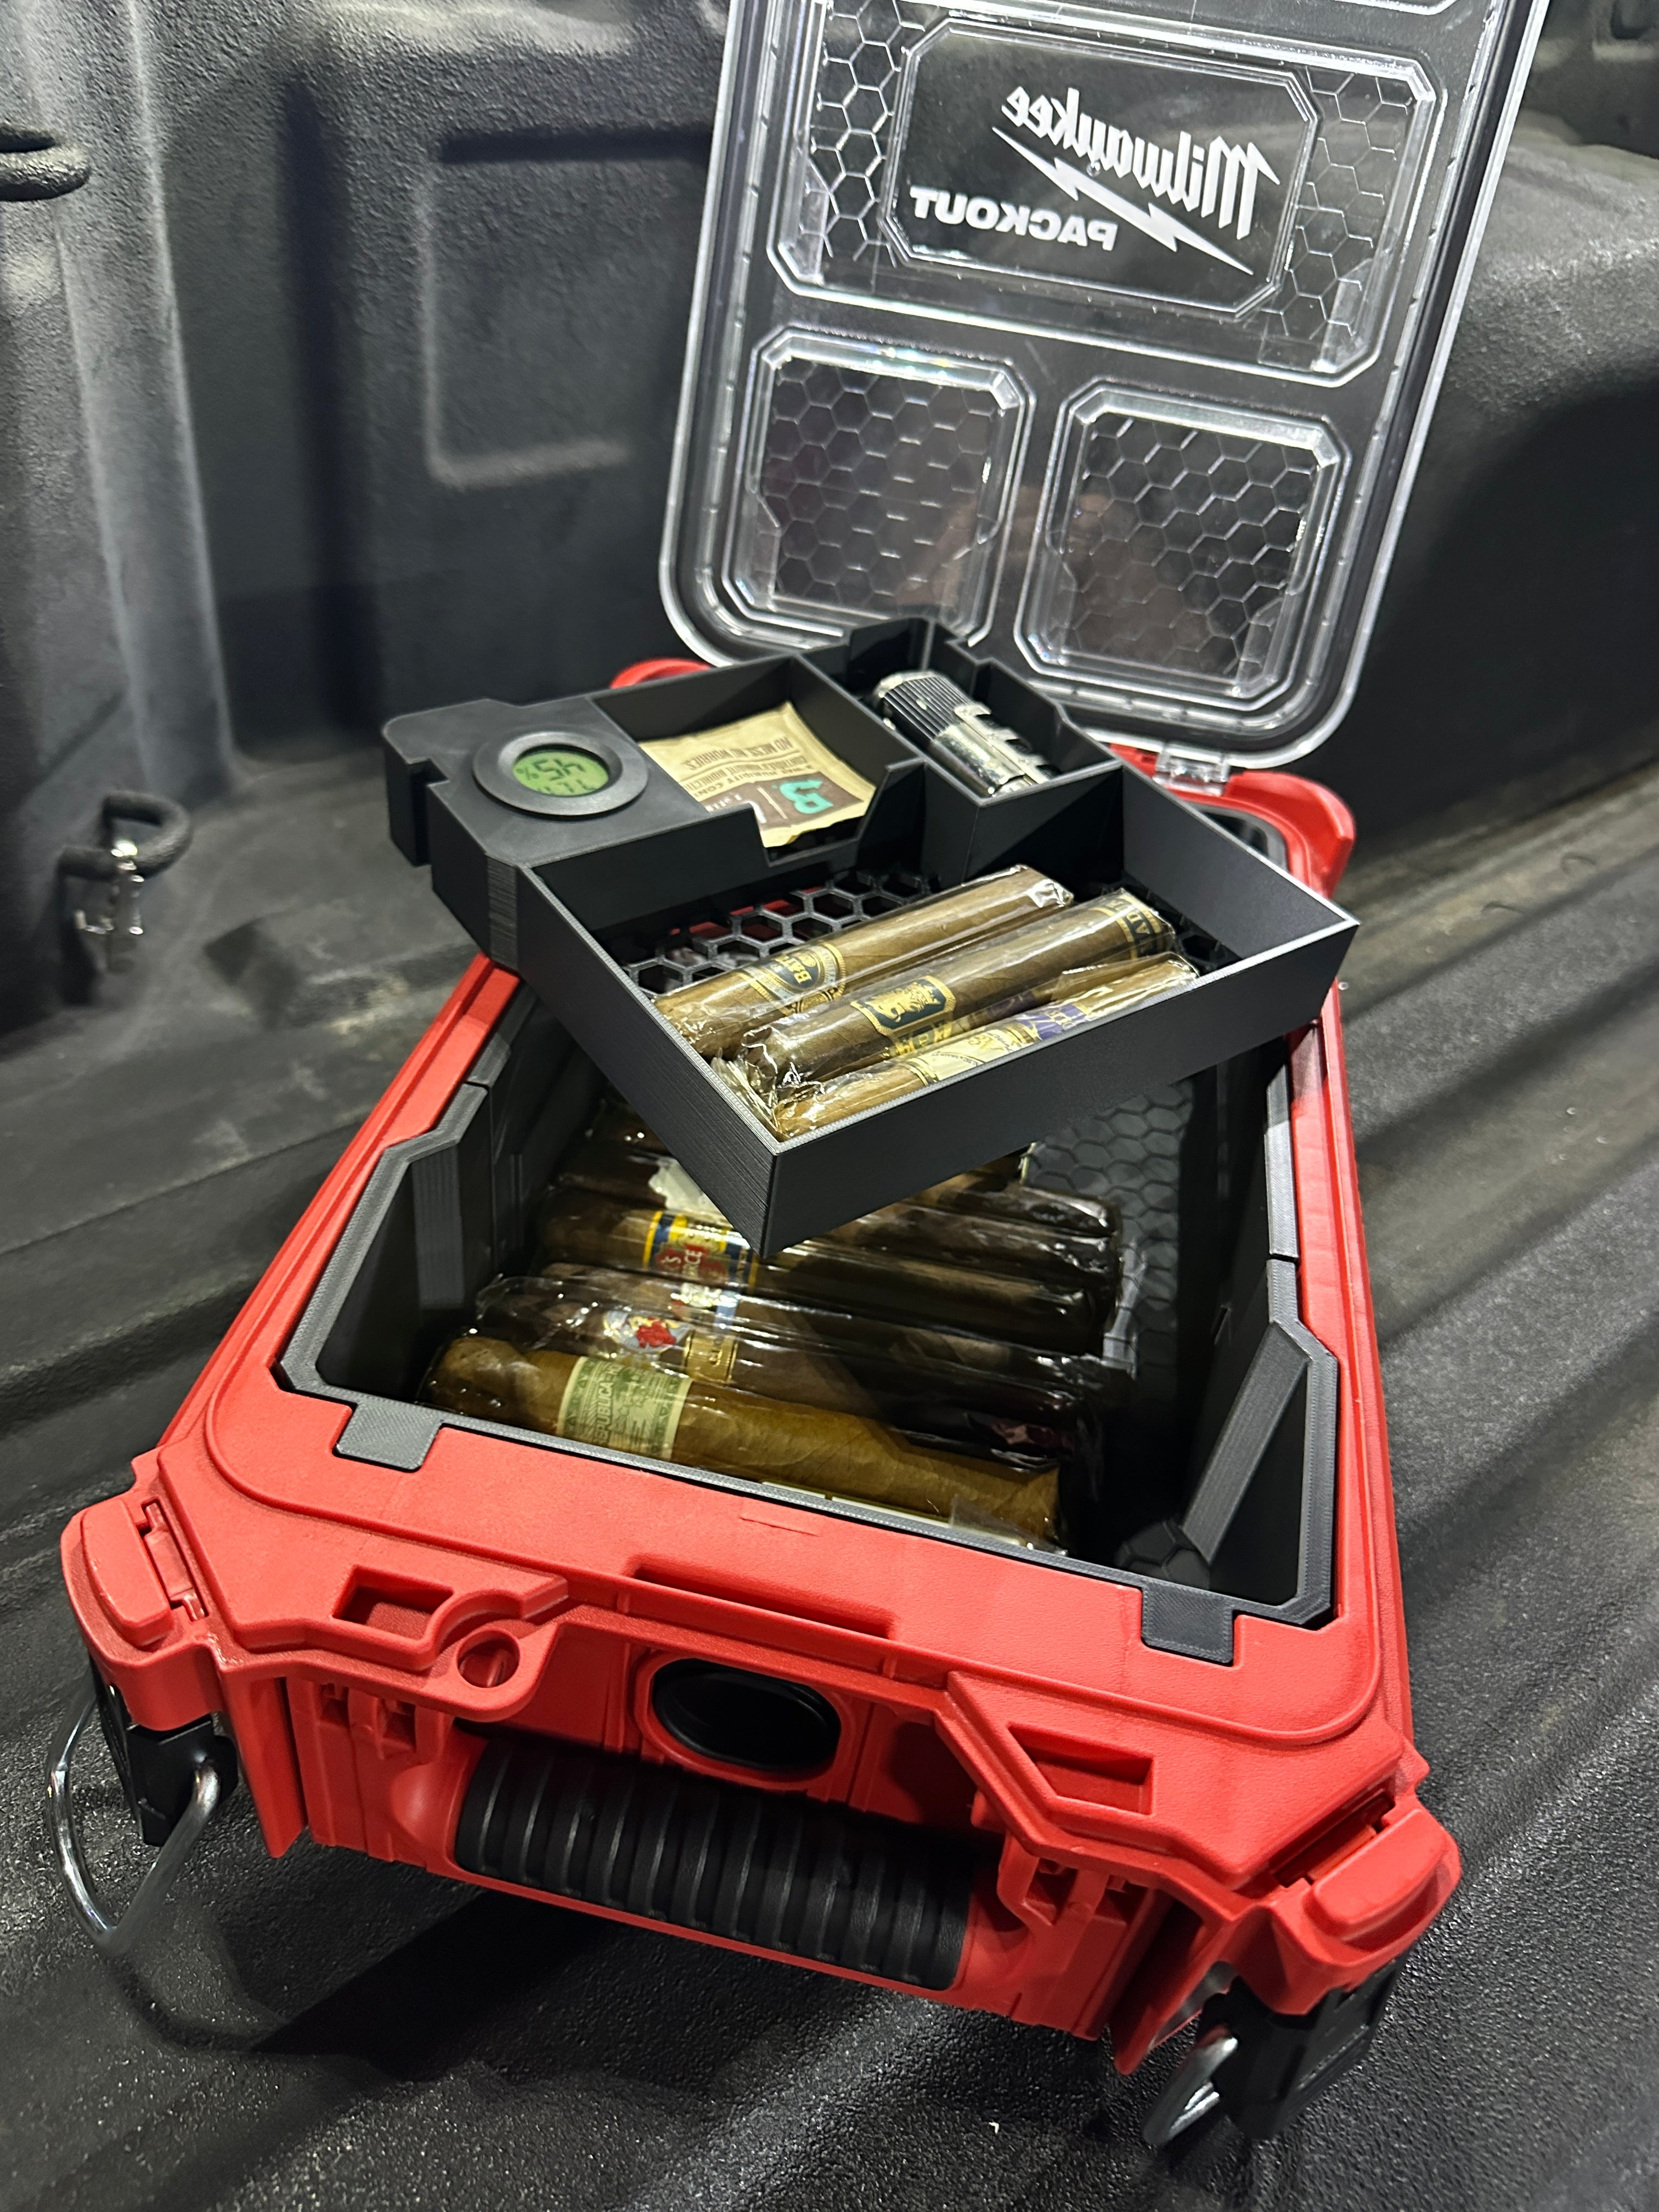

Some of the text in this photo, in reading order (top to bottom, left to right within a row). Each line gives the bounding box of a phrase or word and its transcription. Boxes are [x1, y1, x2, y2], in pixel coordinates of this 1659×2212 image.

[749, 743, 778, 758] MESS
[774, 736, 793, 751] NO
[729, 748, 749, 759] NO
